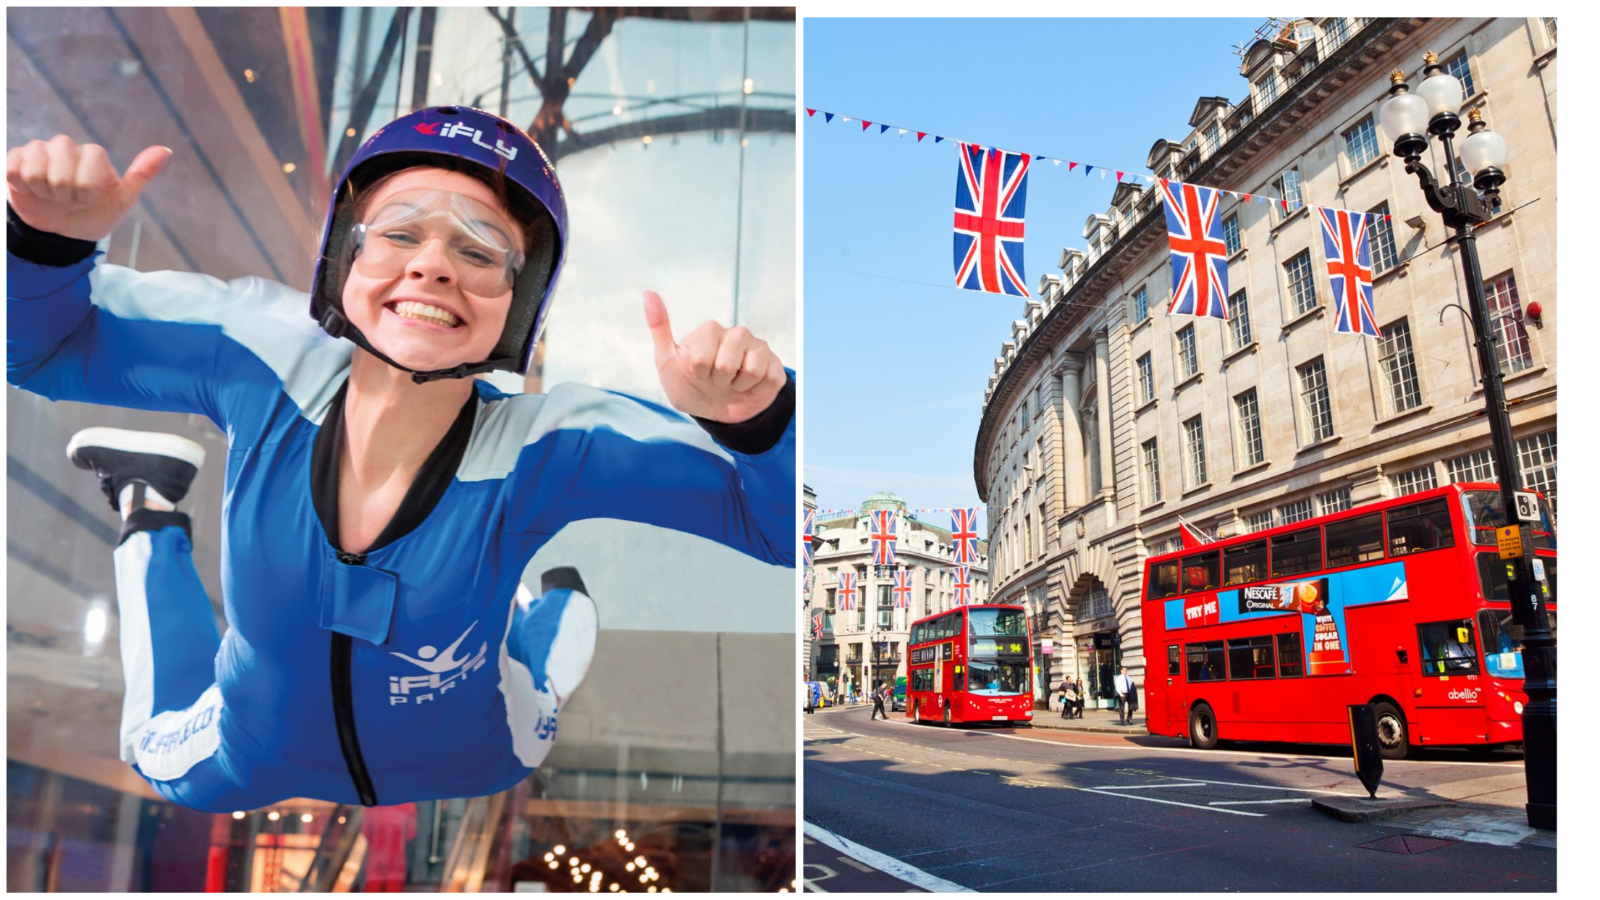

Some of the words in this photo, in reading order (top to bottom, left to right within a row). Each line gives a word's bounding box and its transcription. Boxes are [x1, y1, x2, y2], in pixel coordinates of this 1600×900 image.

[1246, 599, 1275, 609] ORIGINAL
[1186, 605, 1203, 620] TRY
[1203, 601, 1217, 615] ME
[1316, 615, 1332, 623] WHITE
[1315, 623, 1336, 632] COFFEE
[1315, 632, 1338, 641] SUGAR
[1010, 643, 1021, 652] 94
[1314, 642, 1323, 651] IN
[1324, 640, 1340, 650] ONE
[1448, 688, 1477, 699] abellio
